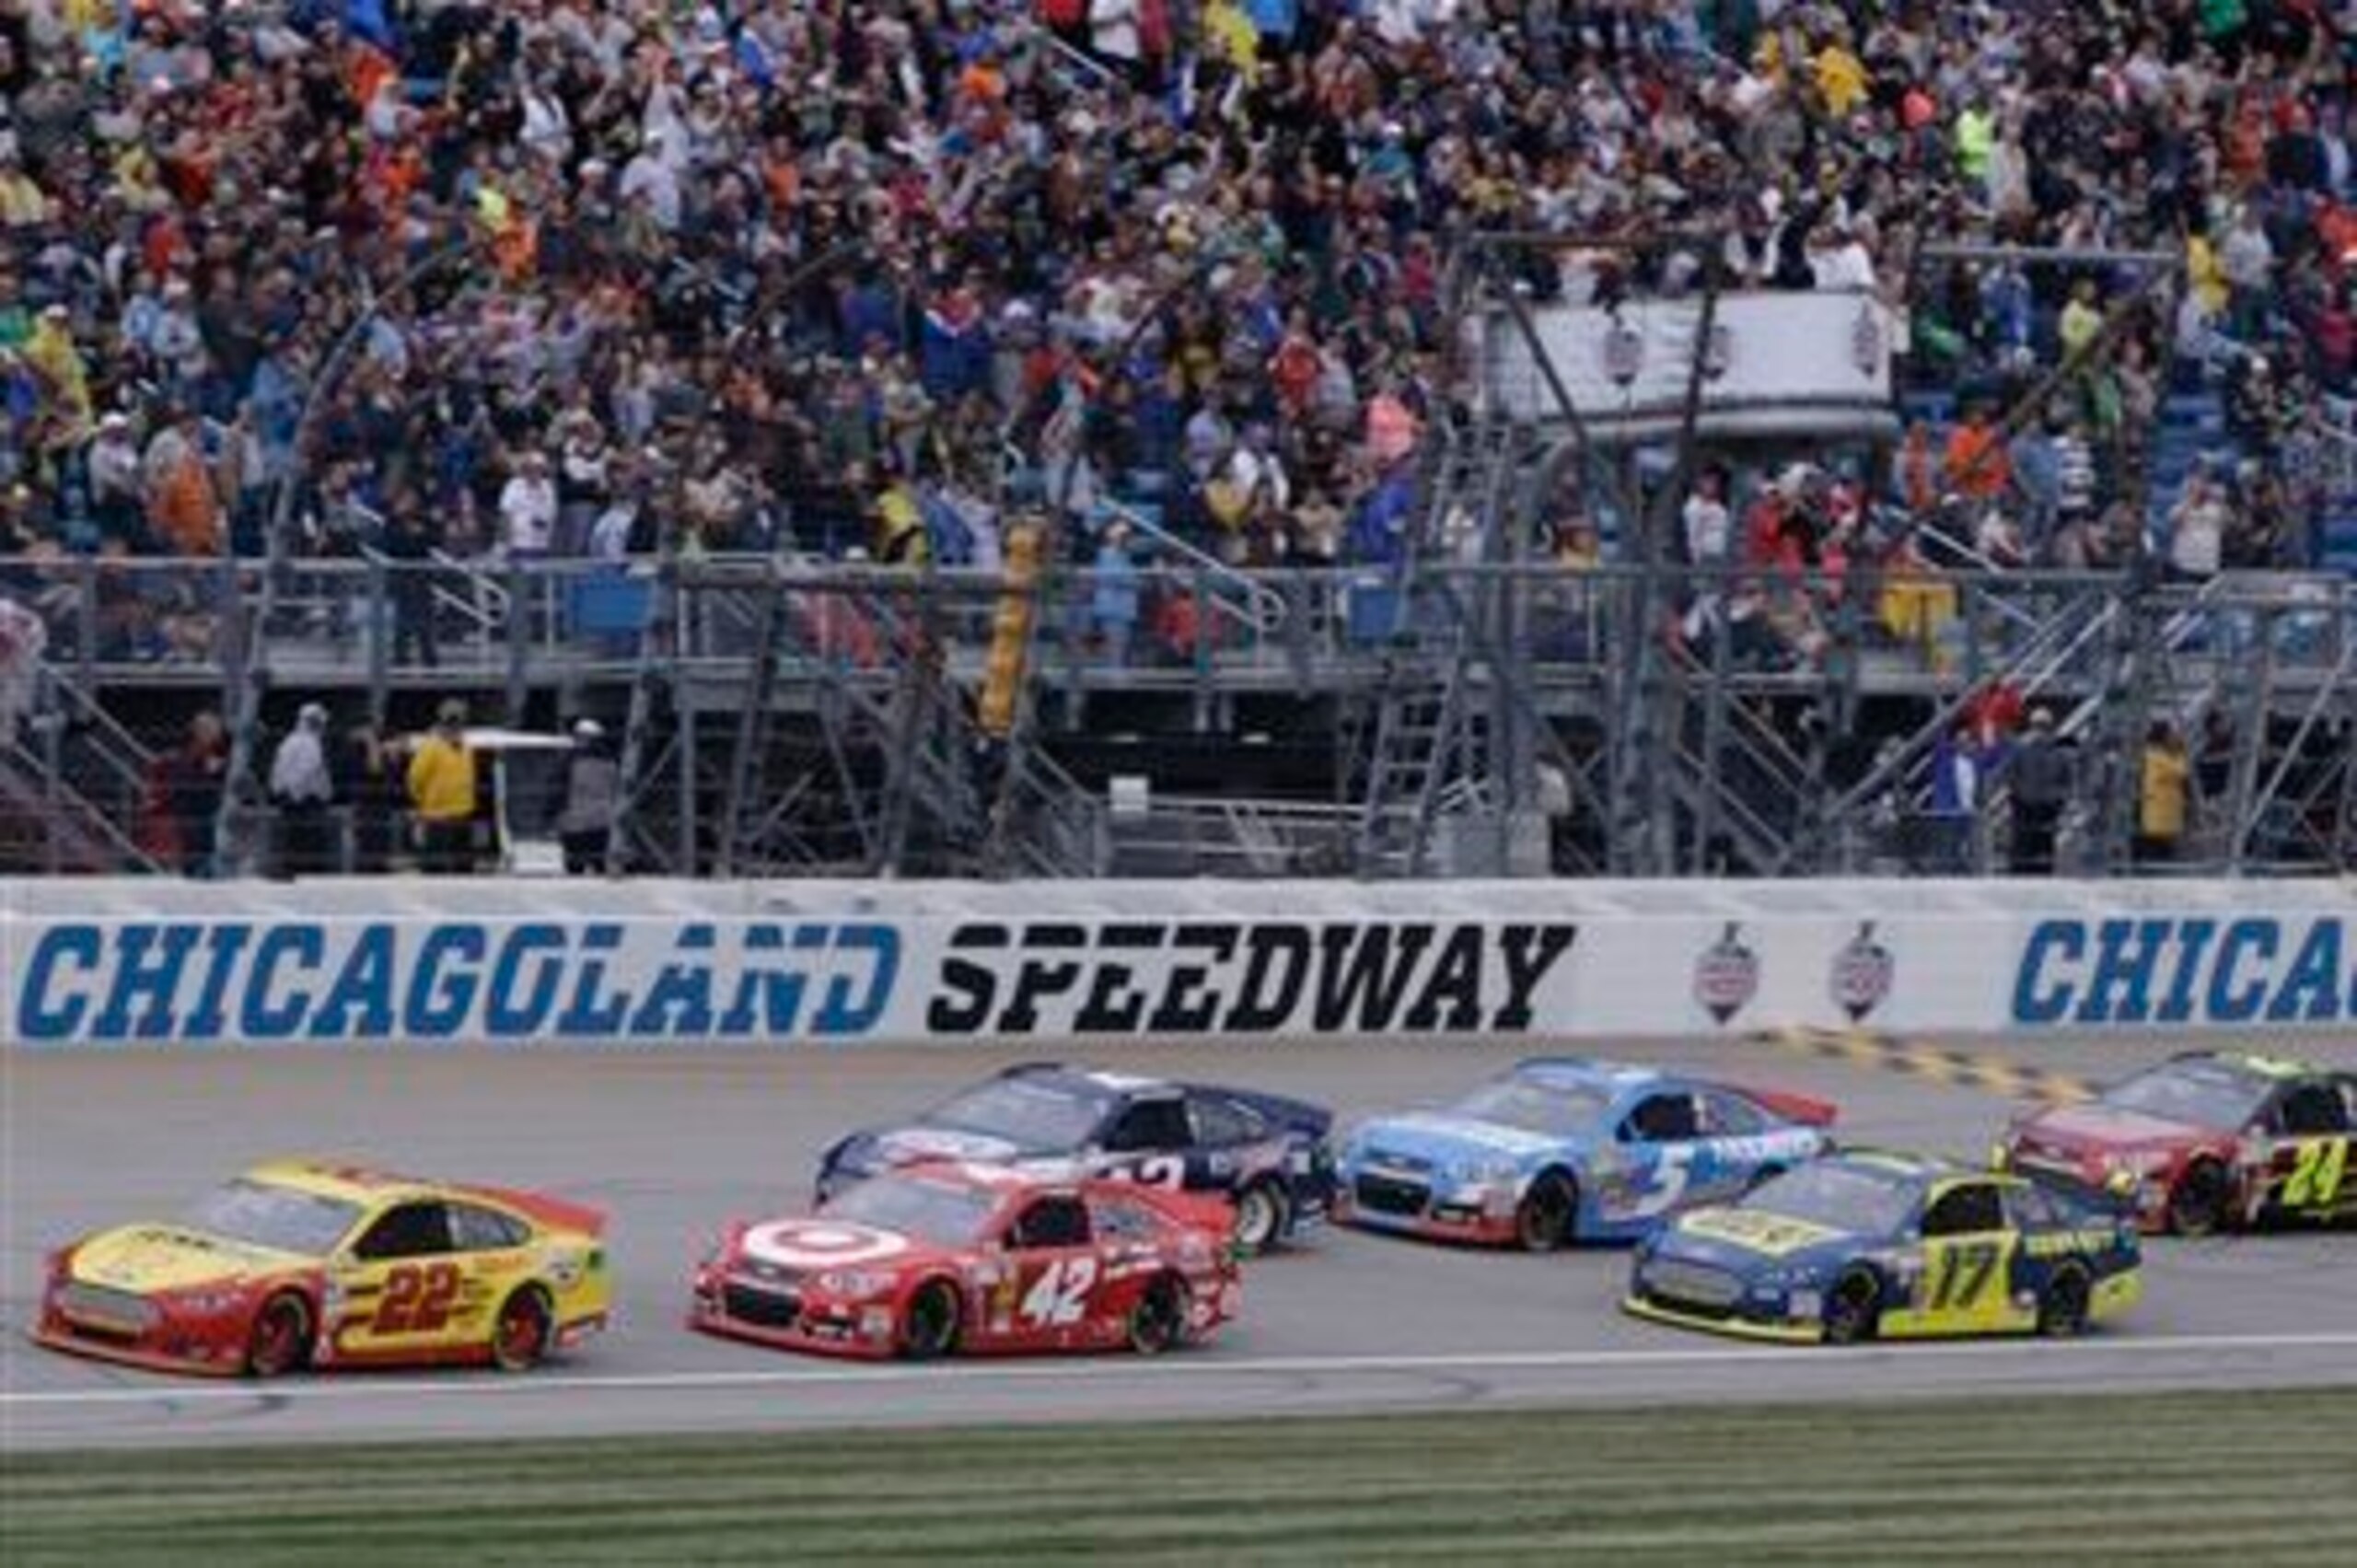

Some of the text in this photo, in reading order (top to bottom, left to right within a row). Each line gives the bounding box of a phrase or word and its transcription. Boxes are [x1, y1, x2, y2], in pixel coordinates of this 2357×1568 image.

[17, 924, 901, 1039] CHICAGOLAND
[926, 924, 1575, 1032] SPEEDWAY
[2013, 919, 2357, 1022] CHICA
[1633, 1144, 1692, 1216] 5
[2282, 1135, 2348, 1206] 24
[372, 1260, 461, 1335] 22
[1020, 1256, 1097, 1326] 42
[1930, 1242, 1999, 1311] 17
